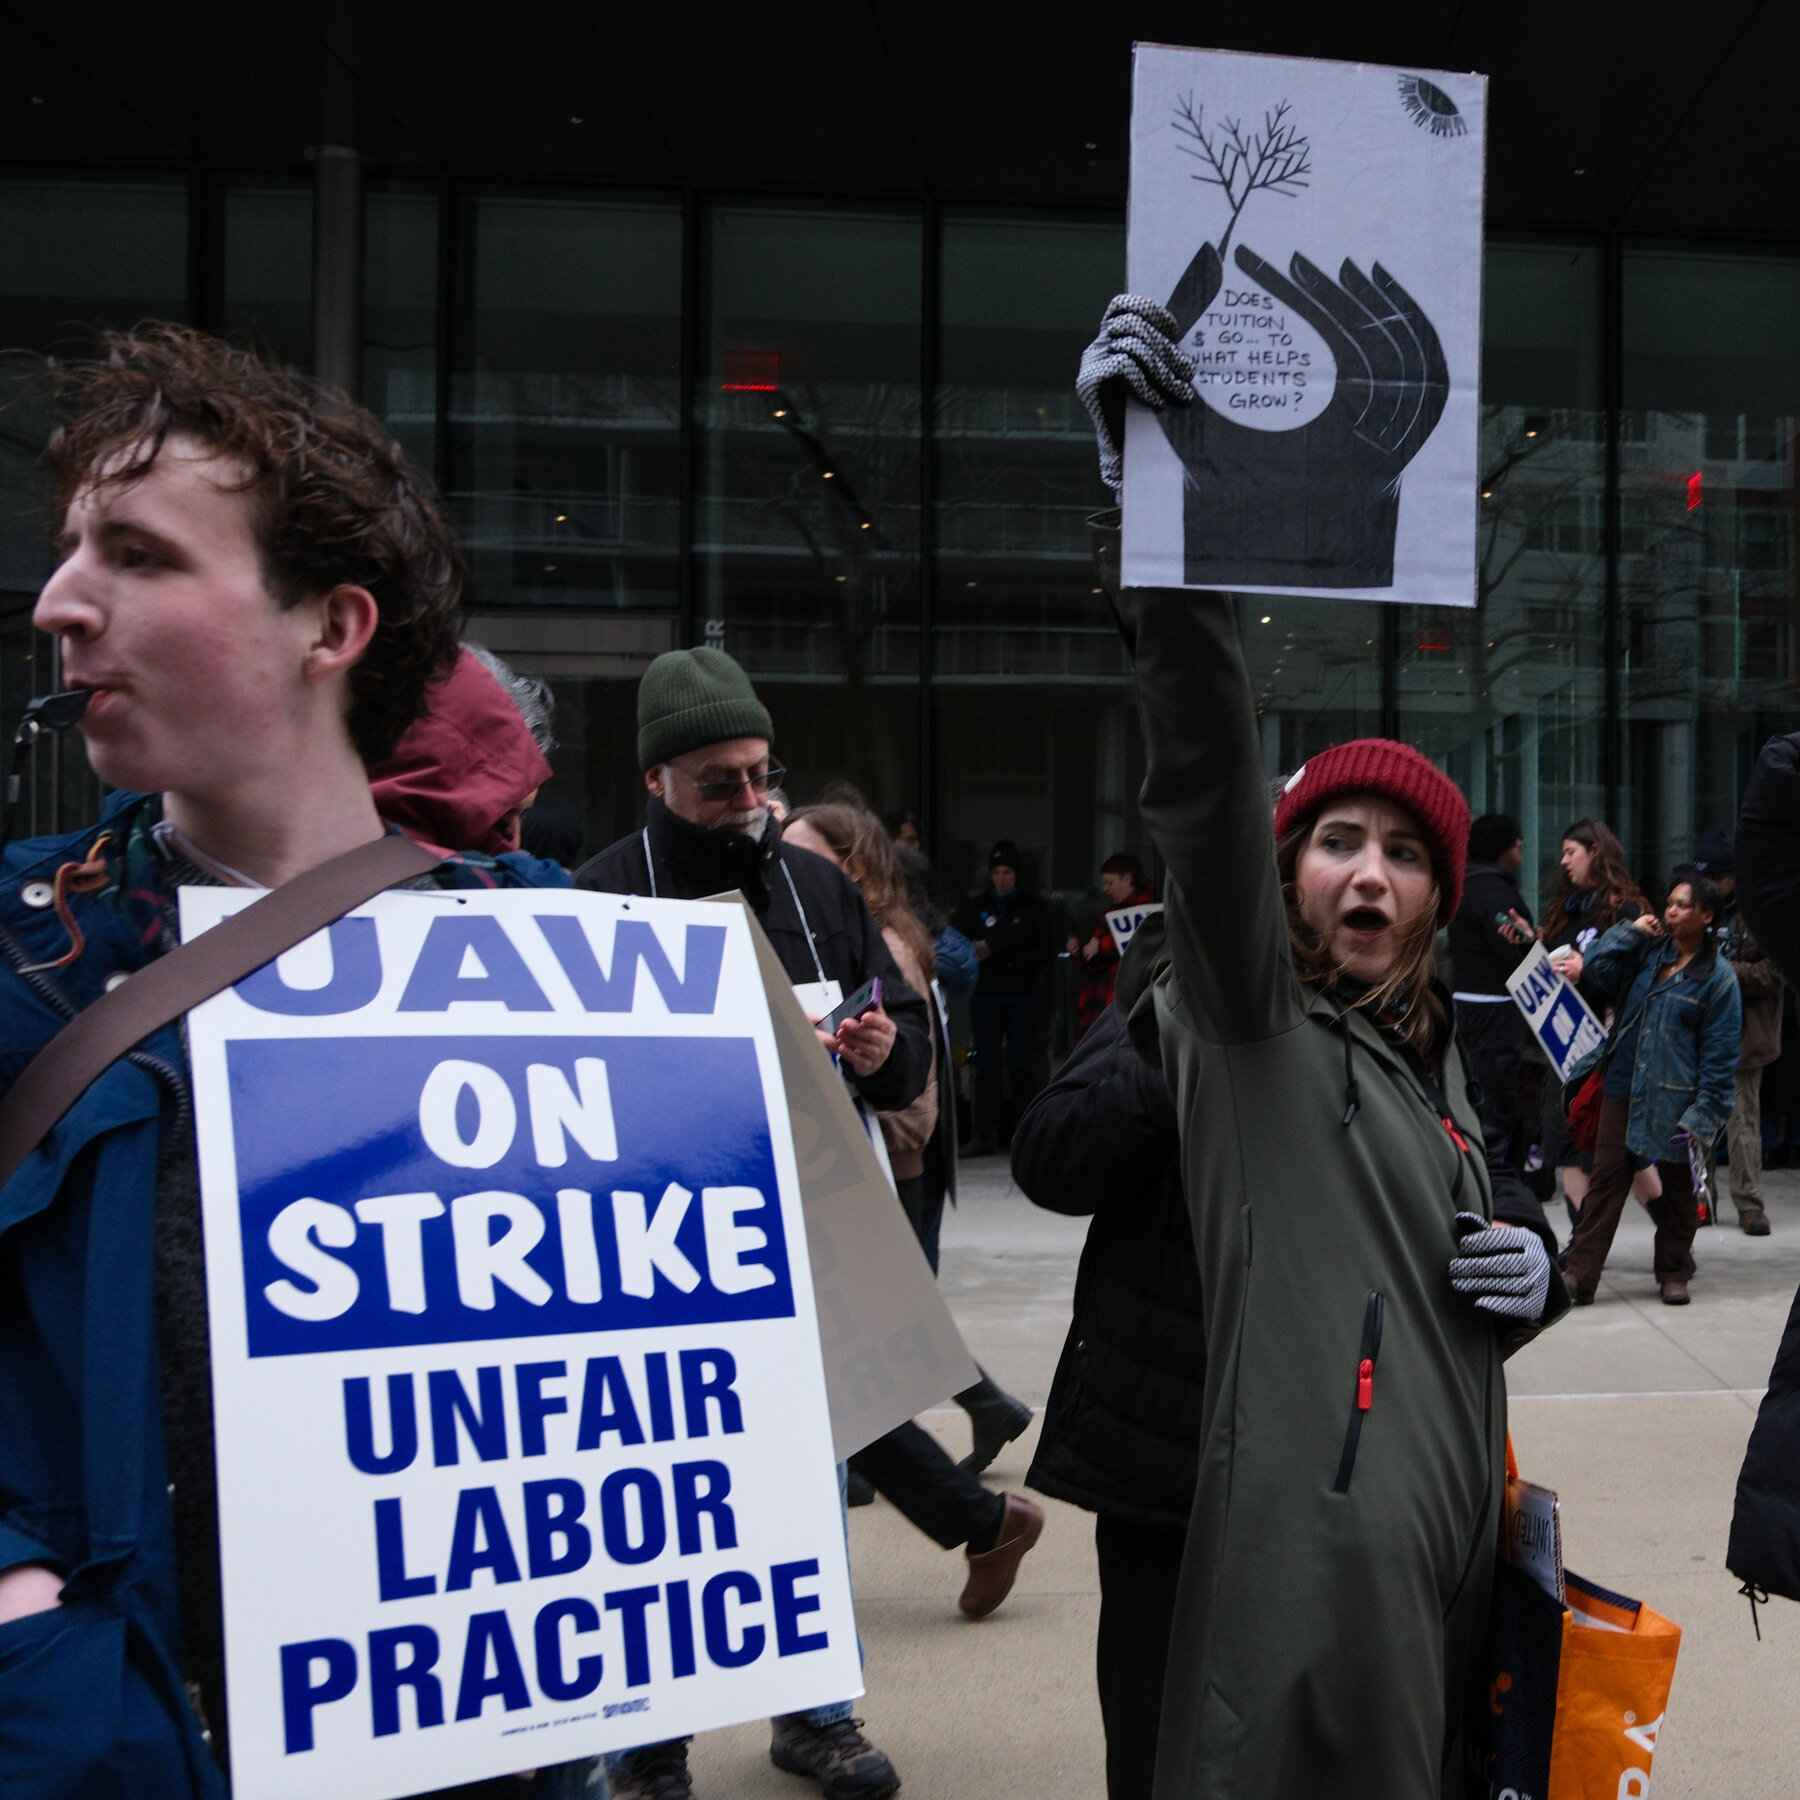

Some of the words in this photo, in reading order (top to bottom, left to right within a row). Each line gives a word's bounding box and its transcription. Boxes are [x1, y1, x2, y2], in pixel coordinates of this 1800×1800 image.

[1205, 313, 1285, 331] TUITION
[1225, 289, 1273, 310] DOES
[1268, 333, 1293, 346] TO
[1199, 371, 1307, 387] STUDENTS
[1248, 351, 1312, 366] HELPS
[221, 914, 728, 1017] UAW
[1514, 955, 1560, 1015] UAW
[418, 1056, 619, 1169] ON
[263, 1181, 776, 1322] STRIKE
[342, 1347, 745, 1475] UNFAIR
[374, 1459, 739, 1603] LABOR
[279, 1557, 830, 1757] PRACTICE
